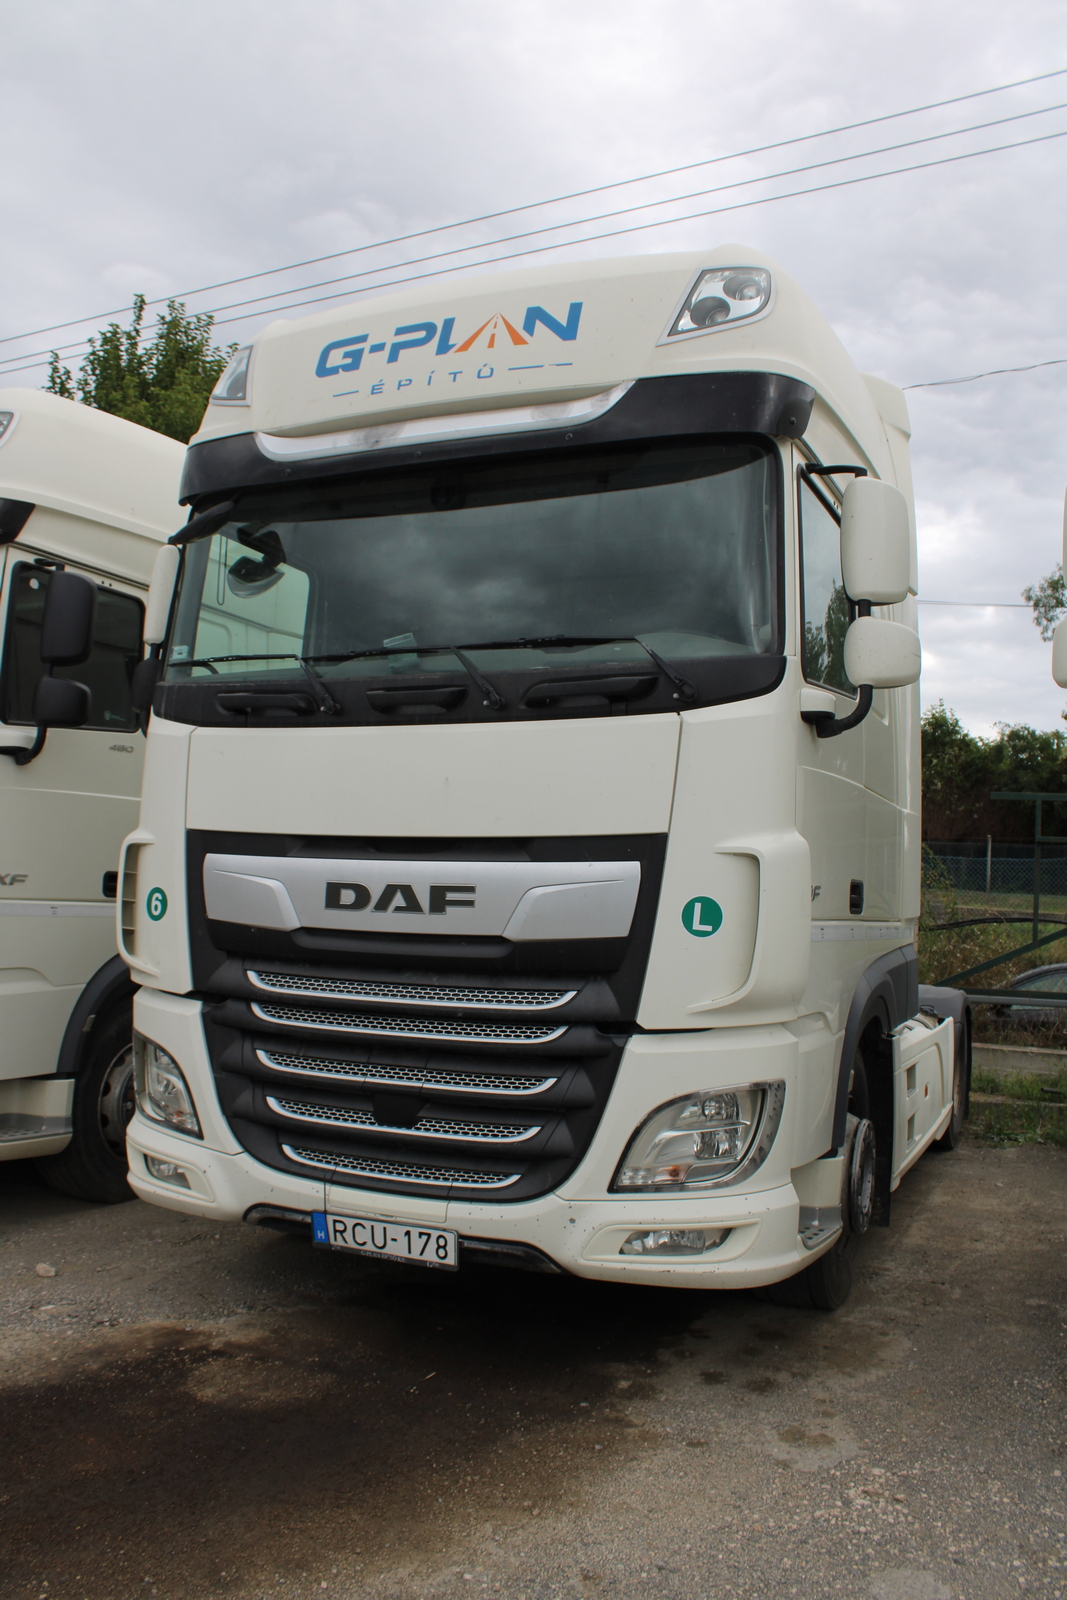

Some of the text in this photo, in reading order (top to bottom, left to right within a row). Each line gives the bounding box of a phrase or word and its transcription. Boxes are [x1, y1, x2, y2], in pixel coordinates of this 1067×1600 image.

[151, 892, 162, 916] 6
[325, 880, 476, 915] DAF
[692, 902, 713, 932] L
[317, 1230, 325, 1240] H
[332, 1218, 448, 1261] RCU-178
